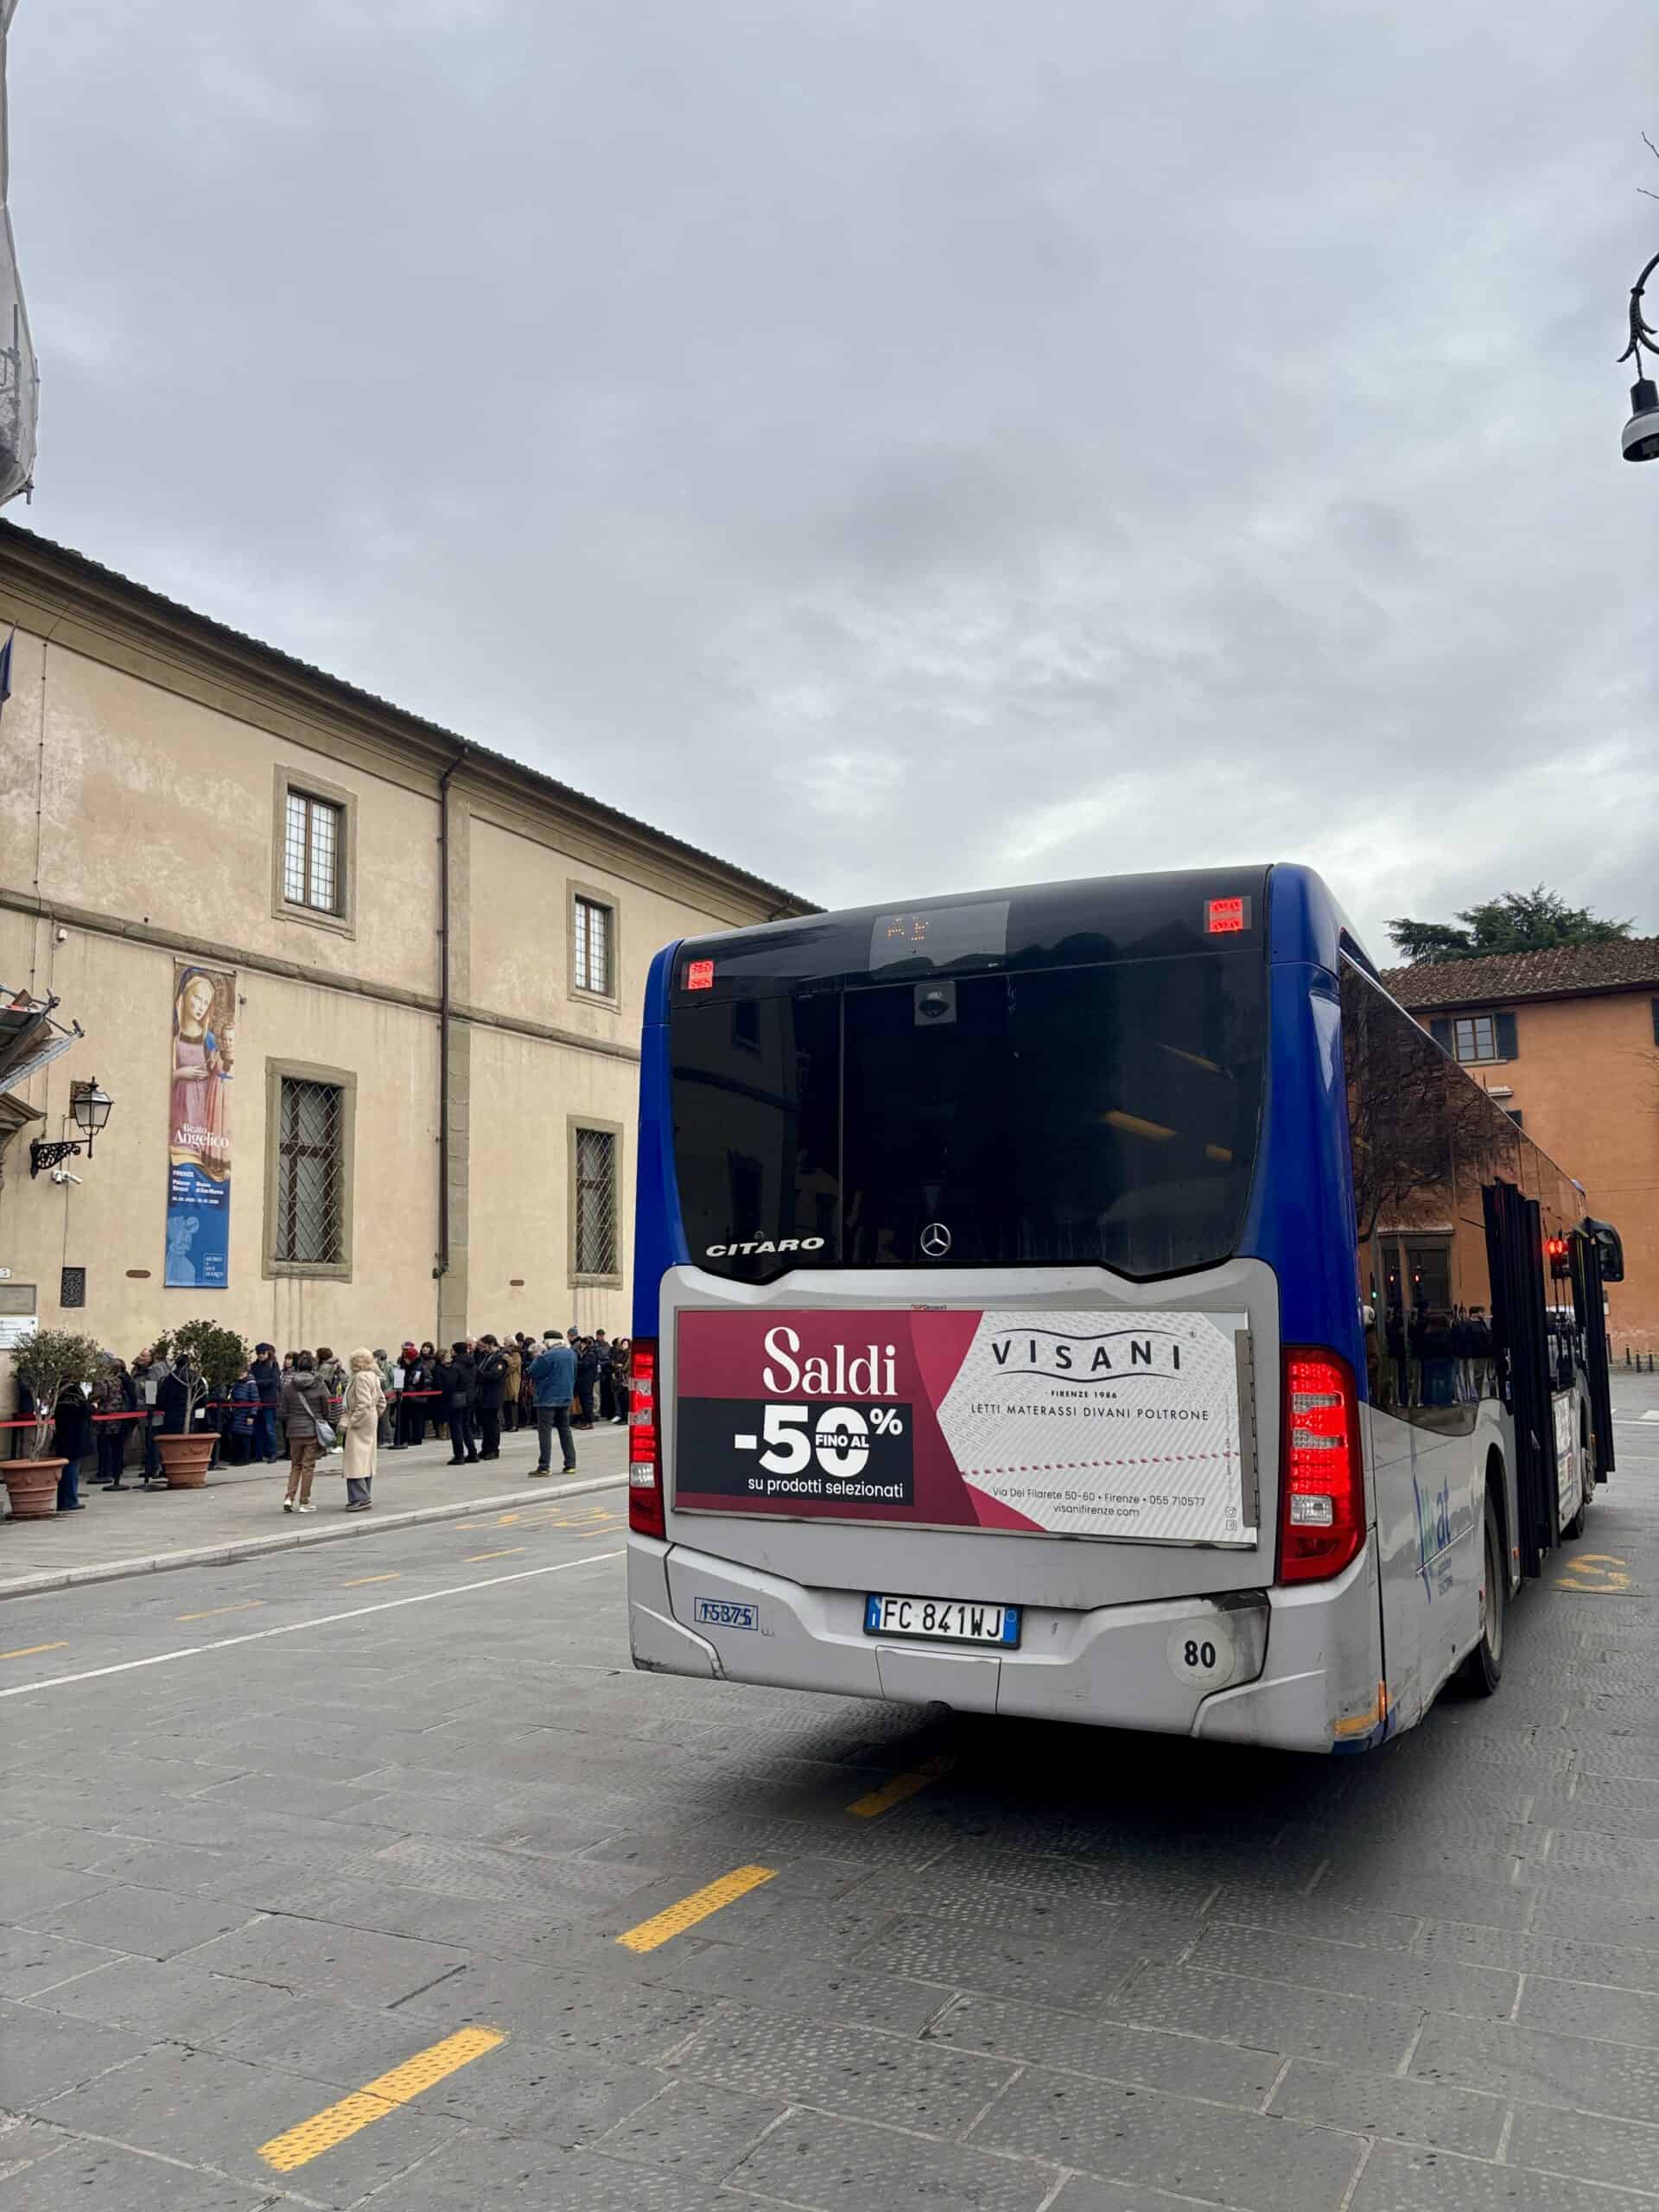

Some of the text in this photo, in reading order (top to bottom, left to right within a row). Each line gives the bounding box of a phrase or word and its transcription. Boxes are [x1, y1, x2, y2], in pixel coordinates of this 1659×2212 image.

[183, 1122, 207, 1135] Beato
[174, 1129, 229, 1149] Angelico
[706, 1237, 824, 1257] CITARO
[763, 1326, 899, 1396] Saldi
[992, 1340, 1181, 1372] VISANI
[1051, 1389, 1089, 1398] FIRENZE
[971, 1403, 1209, 1421] LETTI MATERASSI DIVANI POLTRONE
[816, 1434, 869, 1447] FINO AL
[748, 1478, 904, 1498] su prodotti selezionati
[993, 1487, 1007, 1497] Via
[1027, 1489, 1063, 1500] Filarete
[1065, 1491, 1096, 1502] 50-60
[1104, 1493, 1140, 1504] Firenze
[1052, 1503, 1141, 1516] visanifirenze.com
[1185, 1640, 1216, 1669] 80
